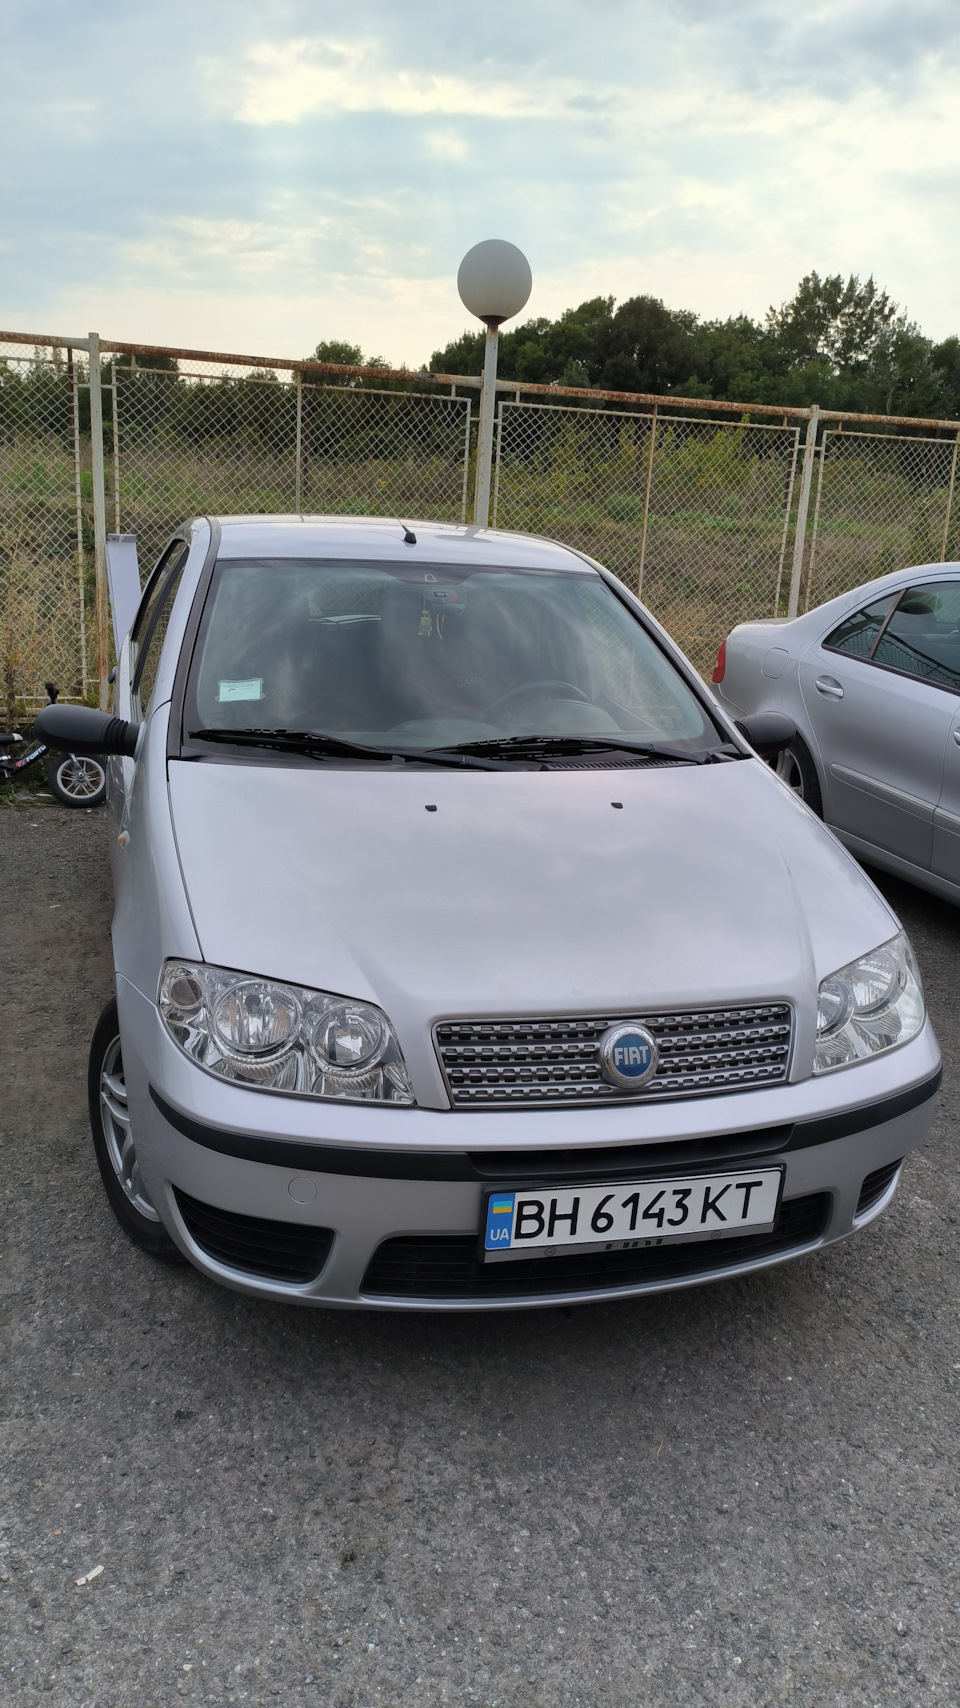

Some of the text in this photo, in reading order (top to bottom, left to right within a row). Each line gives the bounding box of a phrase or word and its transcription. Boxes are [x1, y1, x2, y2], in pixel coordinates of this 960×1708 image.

[25, 744, 47, 763] FORTU
[614, 1046, 649, 1066] FIAT
[514, 1180, 763, 1239] BH 6143 KT
[490, 1228, 510, 1241] UA
